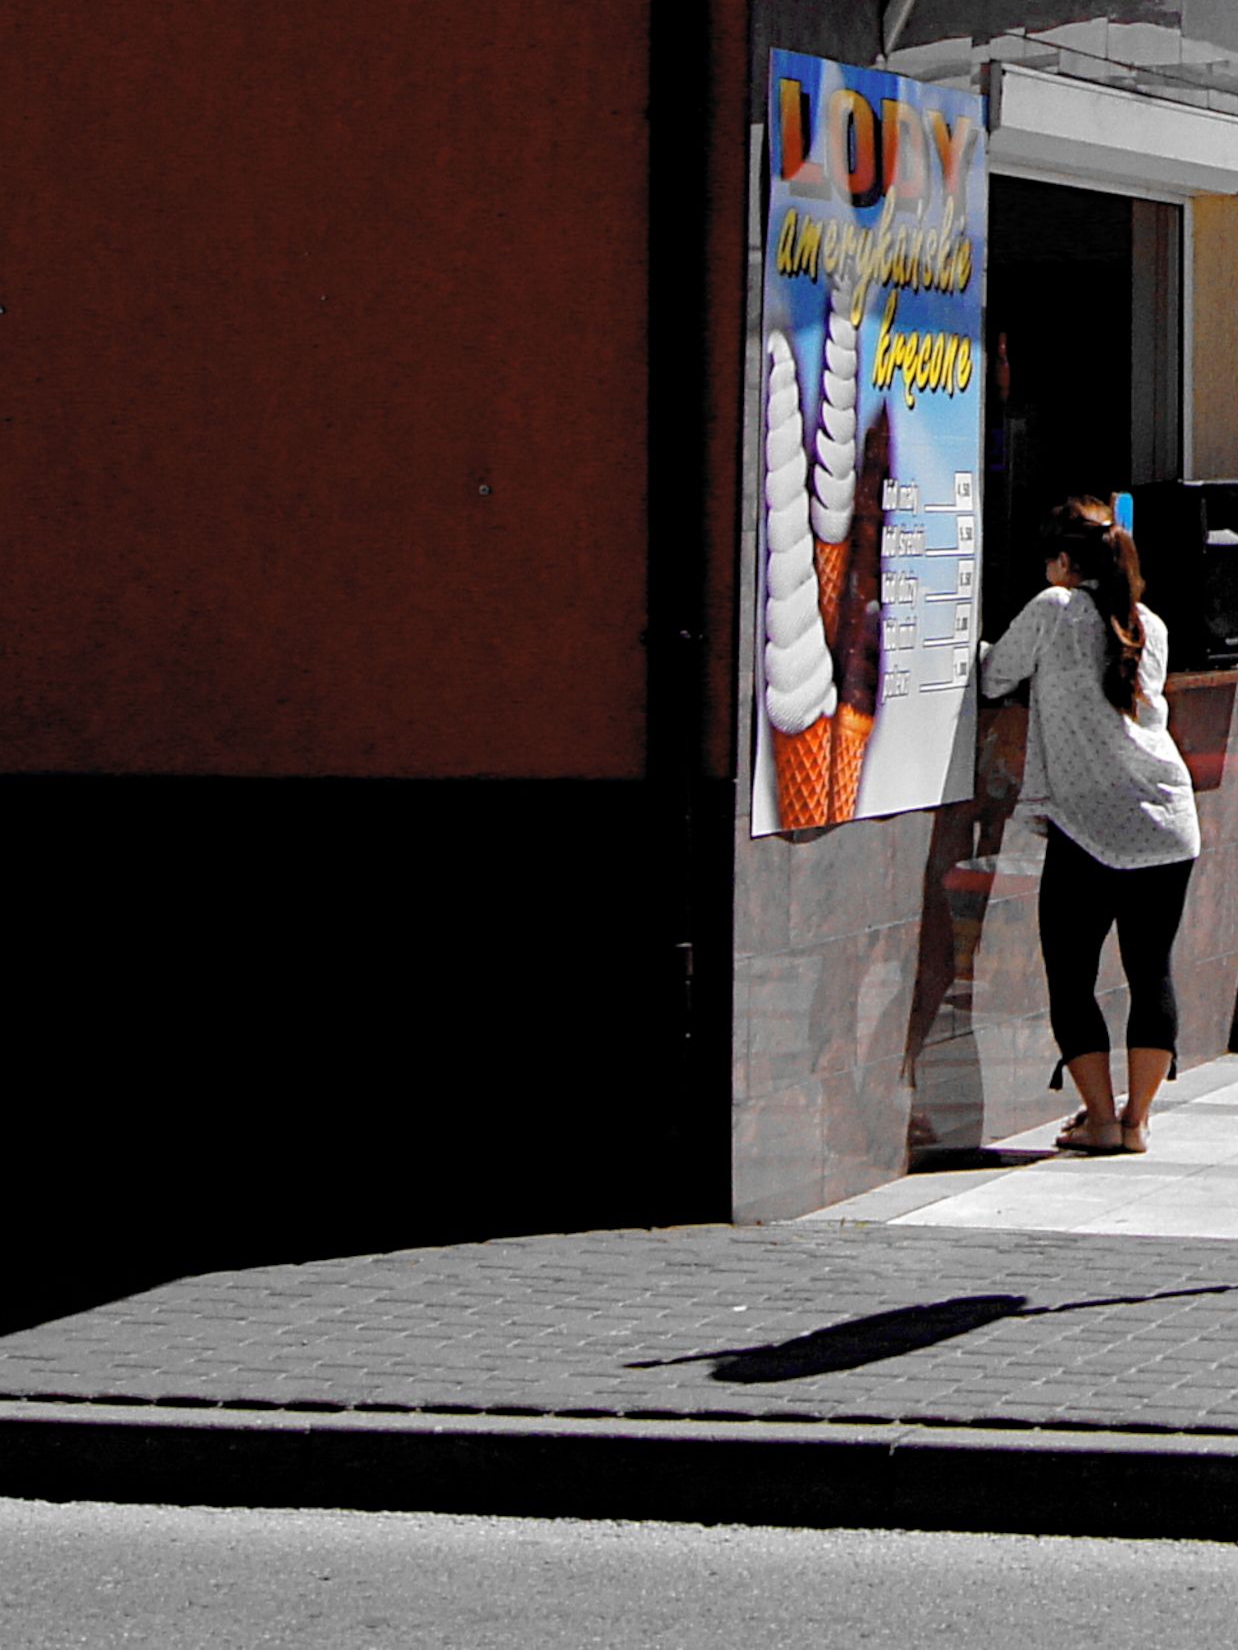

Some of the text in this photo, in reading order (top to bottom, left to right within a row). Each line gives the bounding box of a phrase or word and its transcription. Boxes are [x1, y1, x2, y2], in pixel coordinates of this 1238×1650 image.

[780, 78, 974, 202] LODY
[776, 185, 973, 327] amerykańskie
[873, 289, 973, 407] kręcone
